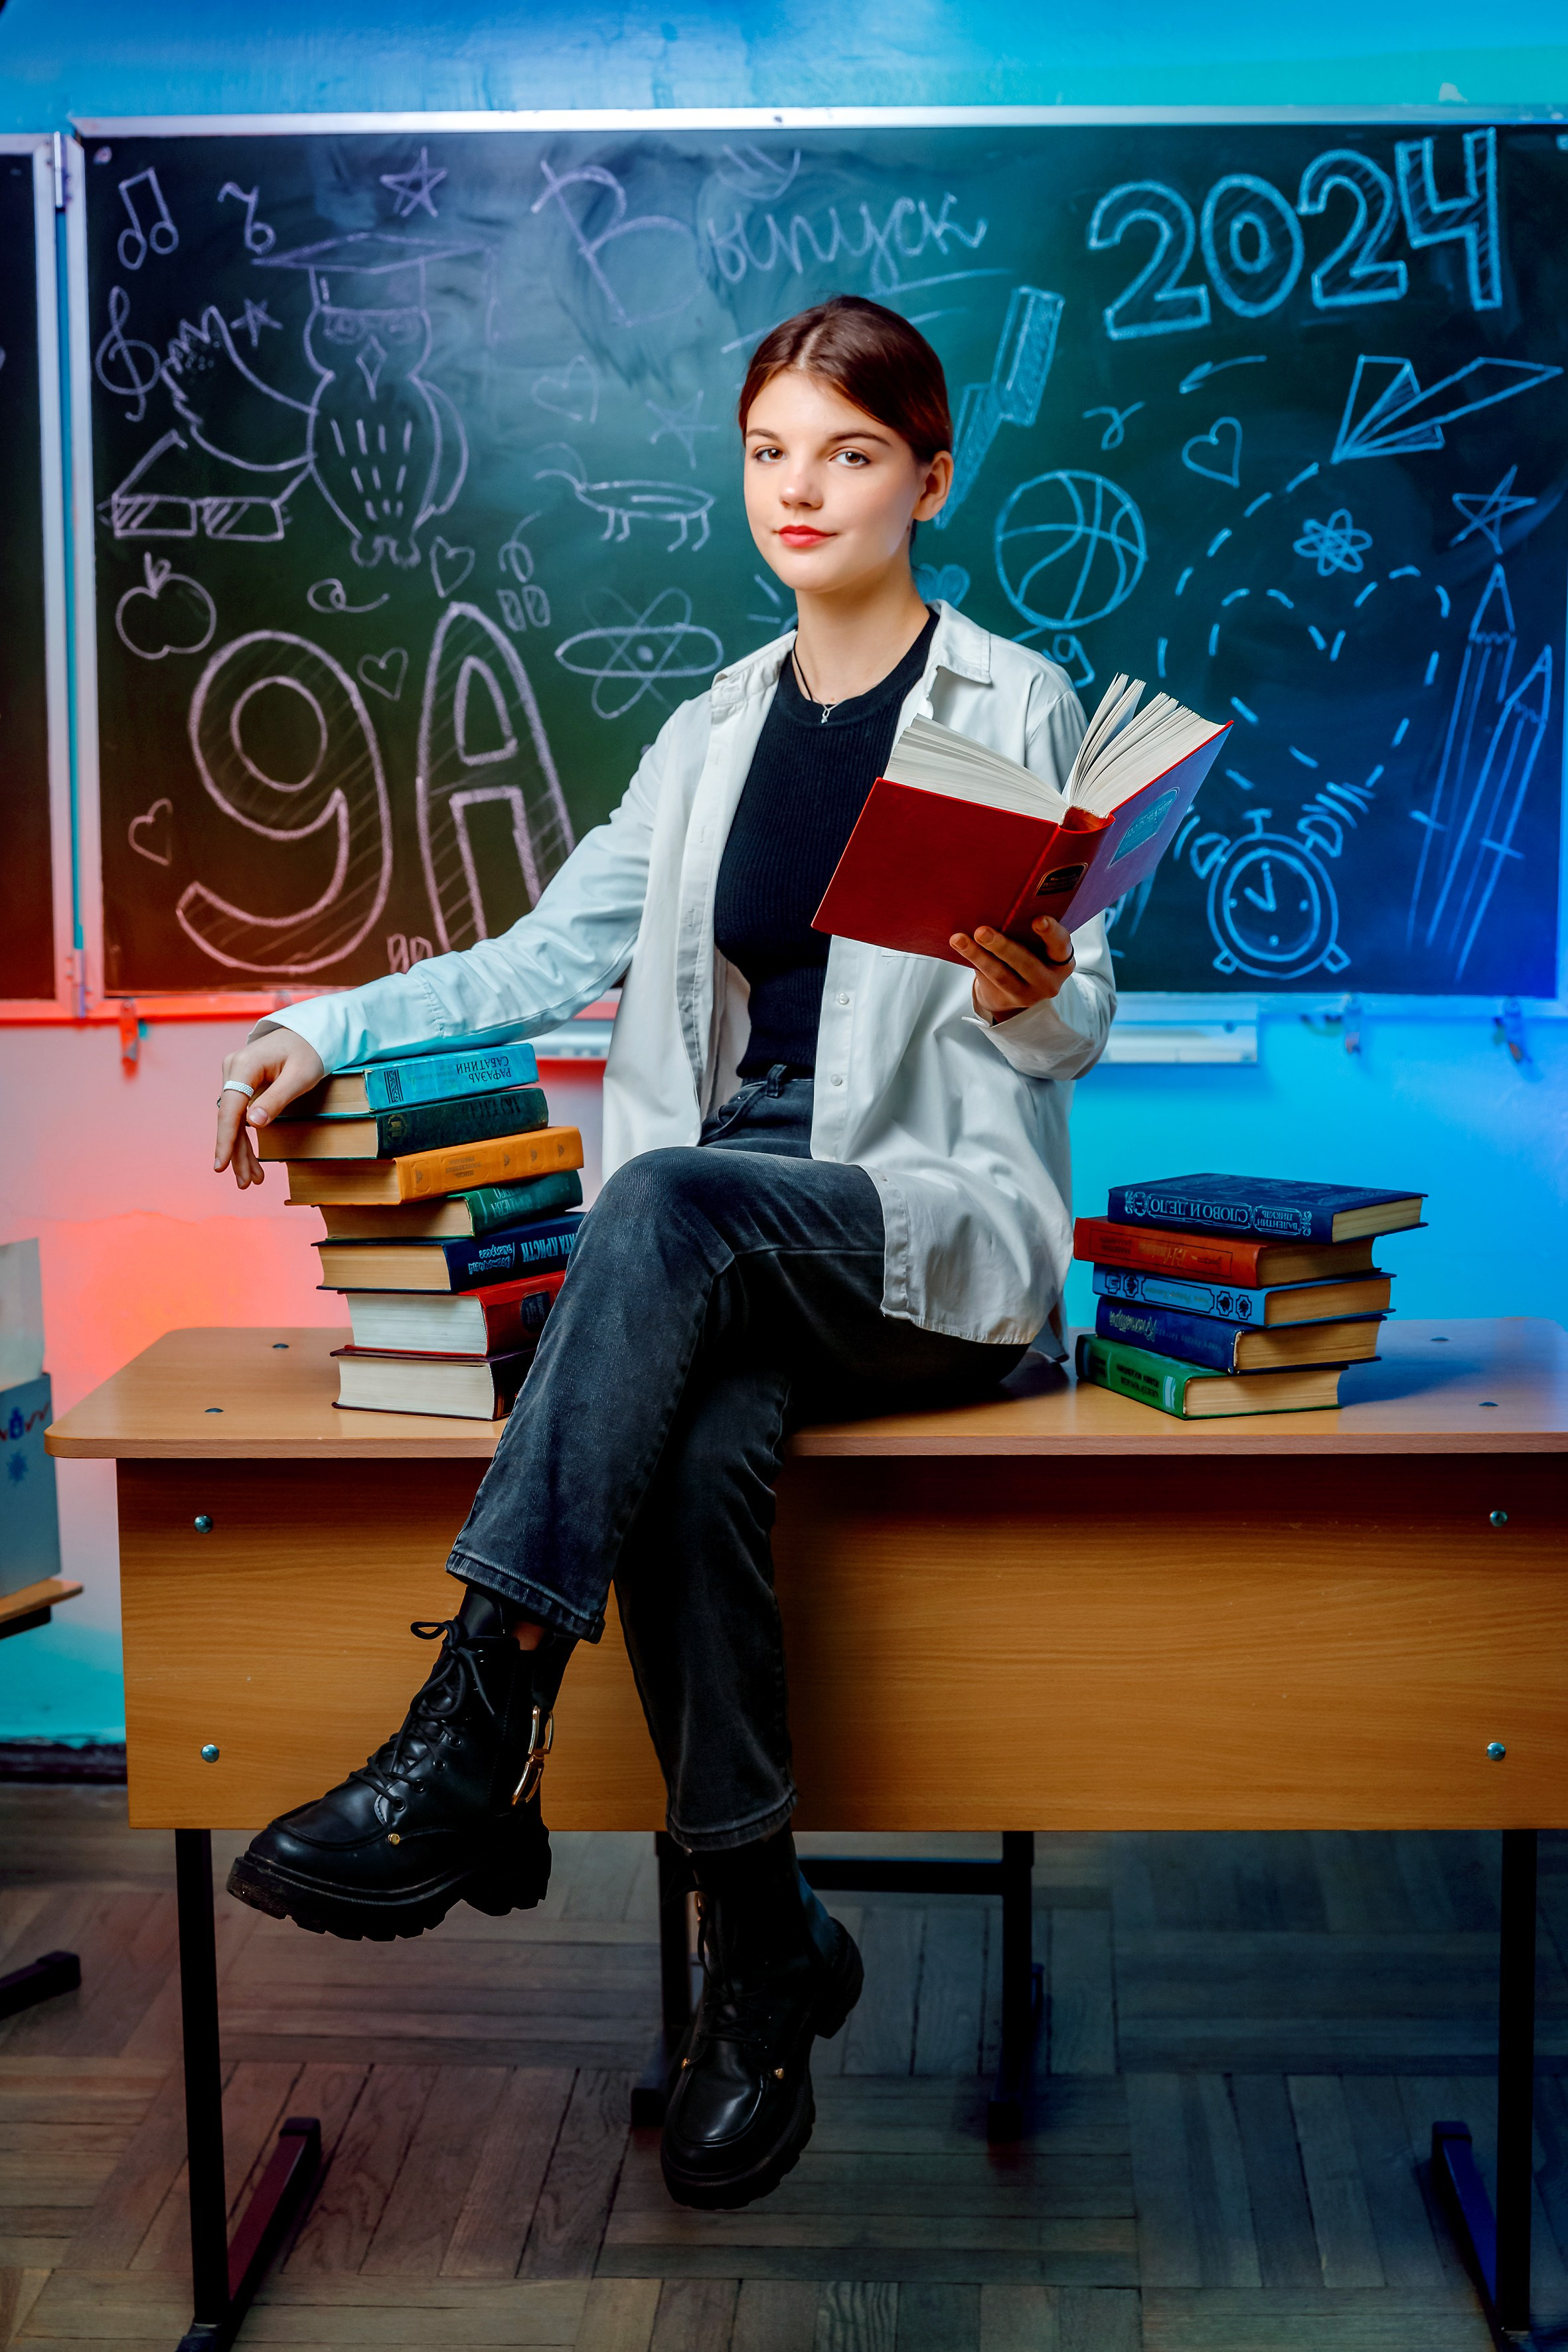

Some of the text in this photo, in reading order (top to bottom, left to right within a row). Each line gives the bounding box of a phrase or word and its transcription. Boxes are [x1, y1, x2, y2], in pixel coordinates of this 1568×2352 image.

[531, 159, 988, 327] Выпуск
[1087, 126, 1502, 341] 2024
[455, 1056, 510, 1074] САБАТИНИ
[467, 1067, 512, 1084] РАФАЭЛЬ
[1150, 1198, 1249, 1223] СЛОВО И ДЕЛО
[1261, 1209, 1293, 1221] ПИКУЛЬ
[1257, 1217, 1298, 1231] ВАЛЕНТИН
[520, 1232, 578, 1263] АТА КРИСТИ
